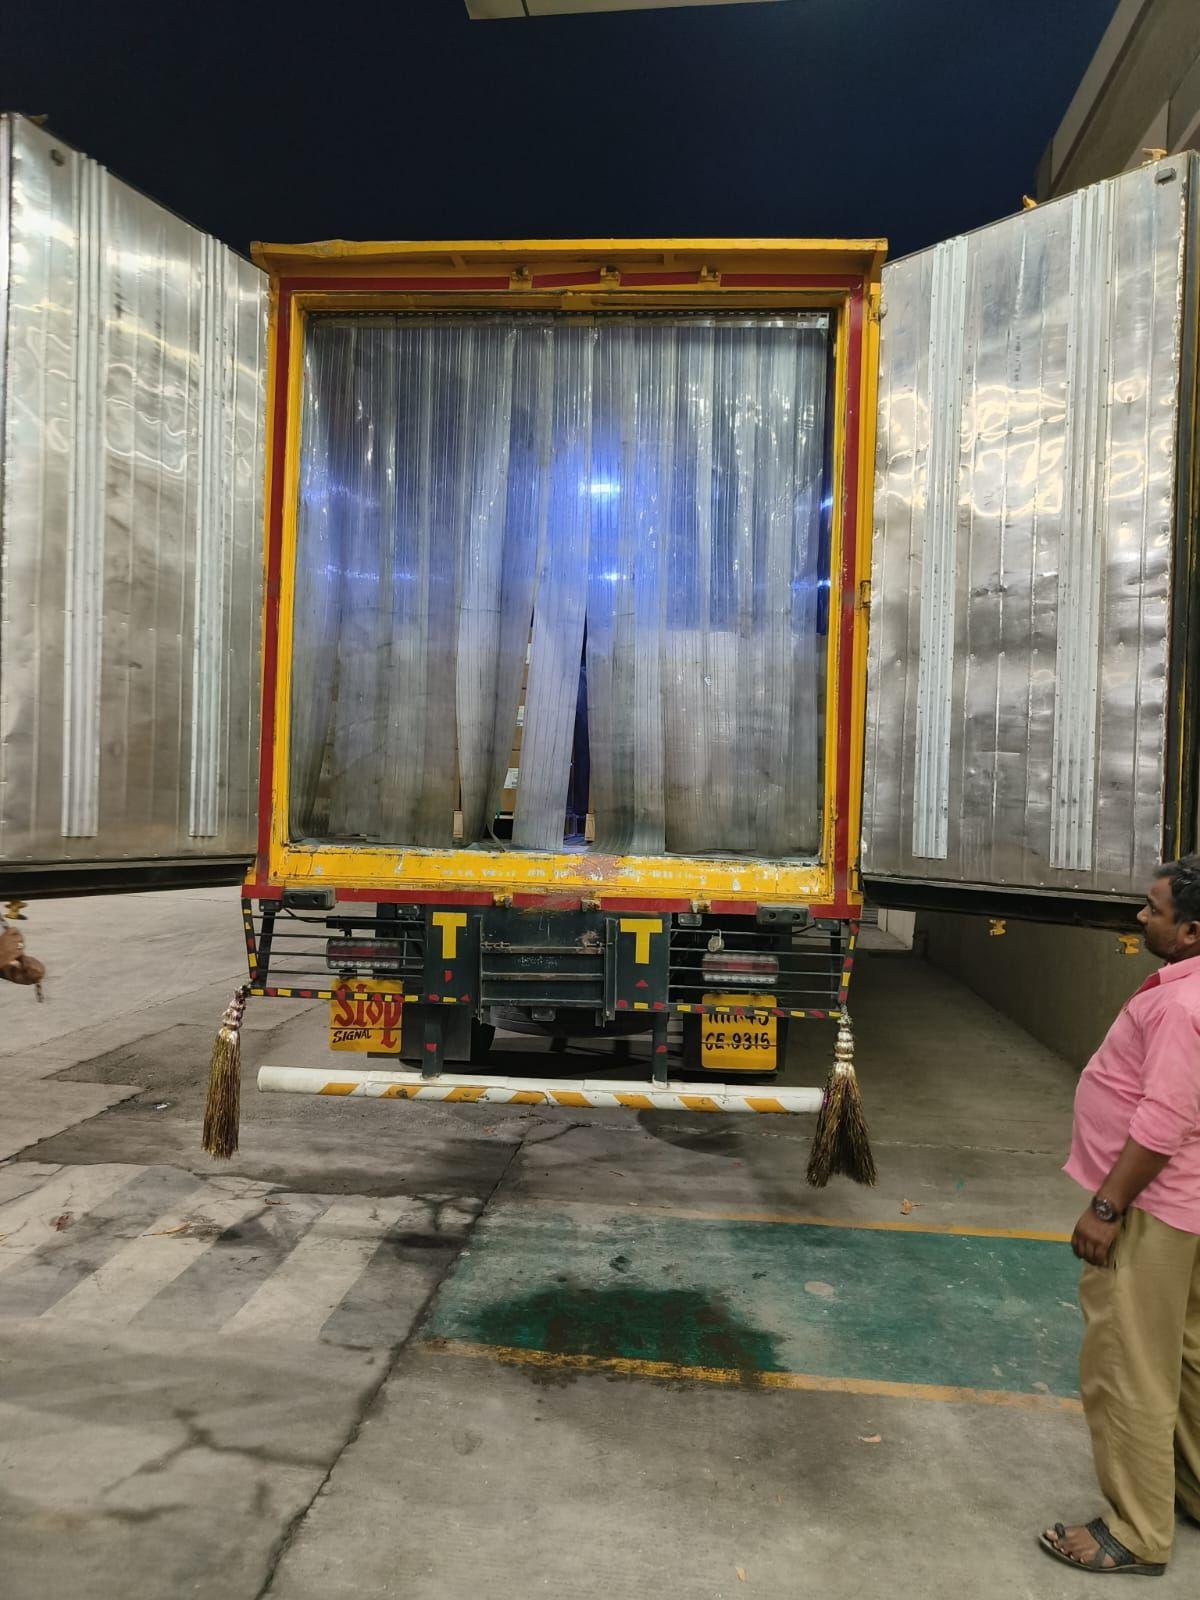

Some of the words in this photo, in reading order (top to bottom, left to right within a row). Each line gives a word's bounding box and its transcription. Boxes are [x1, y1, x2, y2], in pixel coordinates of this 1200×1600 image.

[432, 911, 467, 959] T
[620, 918, 663, 964] T
[332, 1029, 372, 1043] SIGNAL
